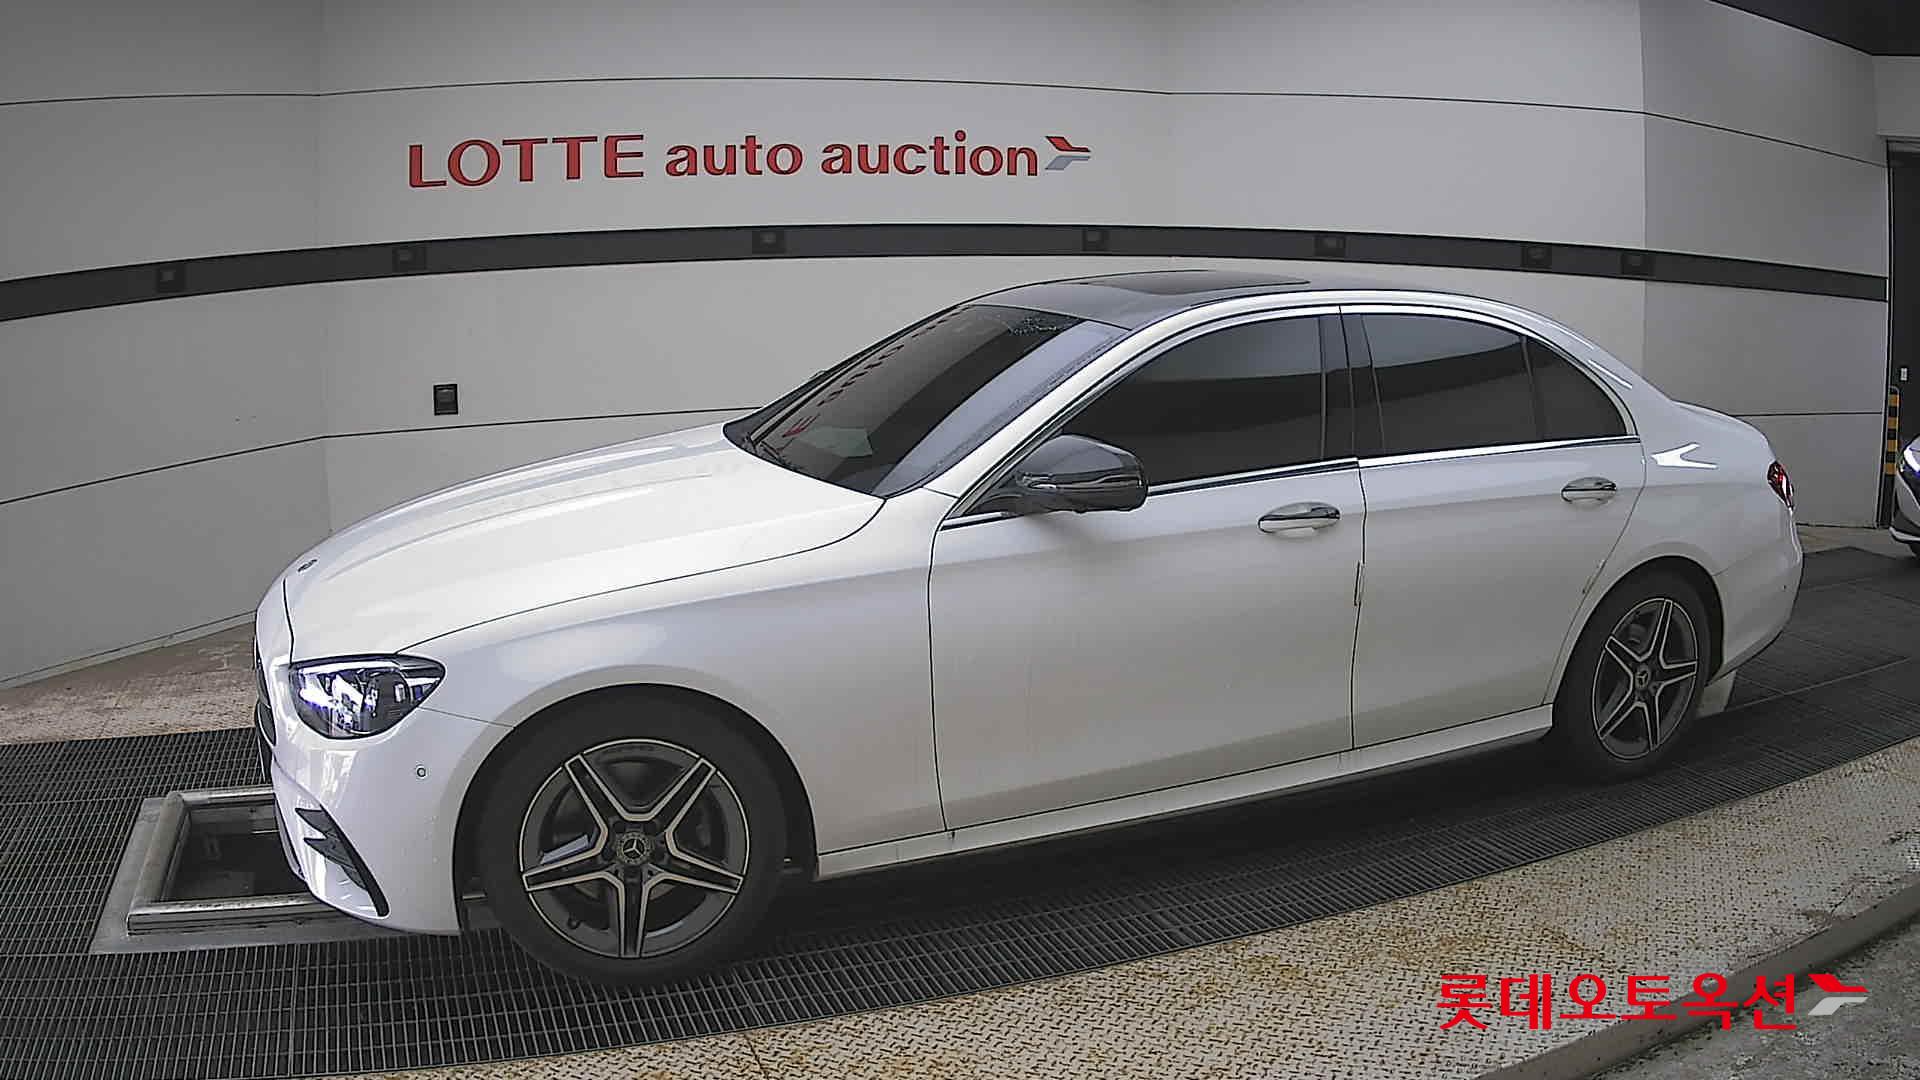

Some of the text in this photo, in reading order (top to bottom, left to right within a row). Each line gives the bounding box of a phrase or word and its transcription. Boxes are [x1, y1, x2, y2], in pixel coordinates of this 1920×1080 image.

[408, 129, 1039, 188] LOTTE auto auction
